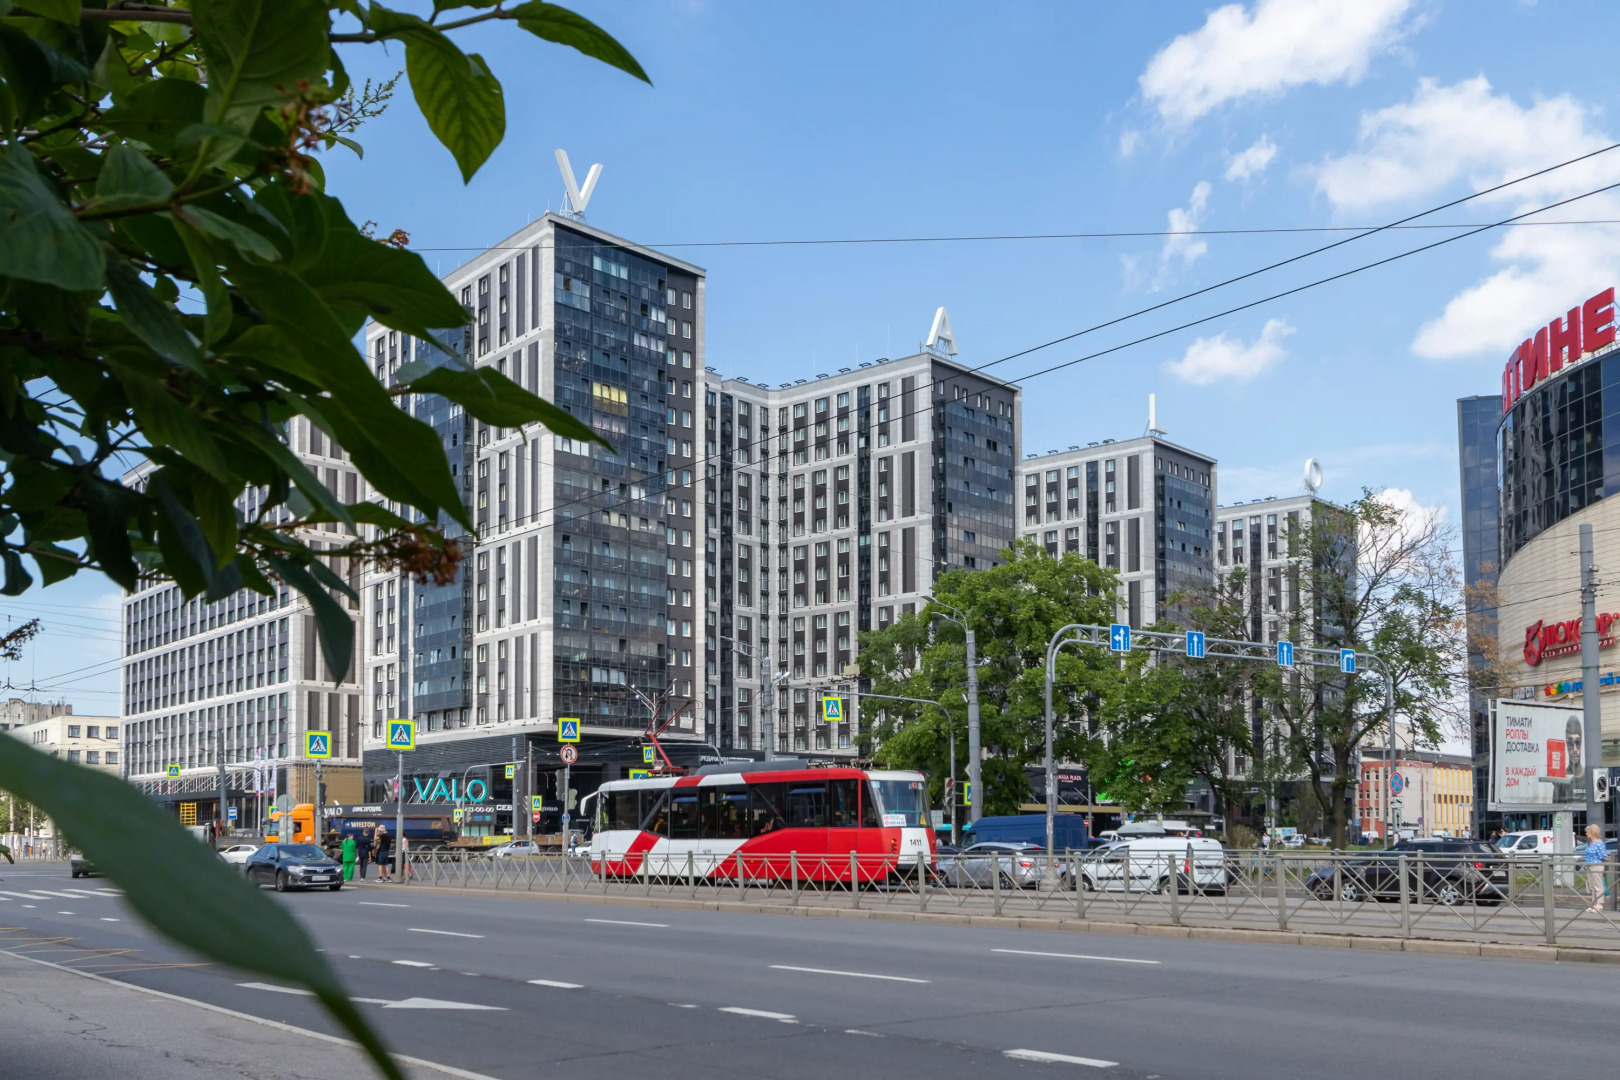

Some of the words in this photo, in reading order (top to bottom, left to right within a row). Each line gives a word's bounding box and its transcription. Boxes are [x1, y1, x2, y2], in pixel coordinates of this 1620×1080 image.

[1505, 716, 1533, 728] ТИМАТИ
[1505, 728, 1529, 740] РОЛЛЫ
[1505, 741, 1540, 754] ДОСТАВКА
[1505, 766, 1510, 776] В
[1511, 765, 1537, 778] КАЖДЫЙ
[1505, 778, 1520, 789] ДОМ
[413, 777, 488, 803] VALO
[909, 838, 922, 847] 1411
